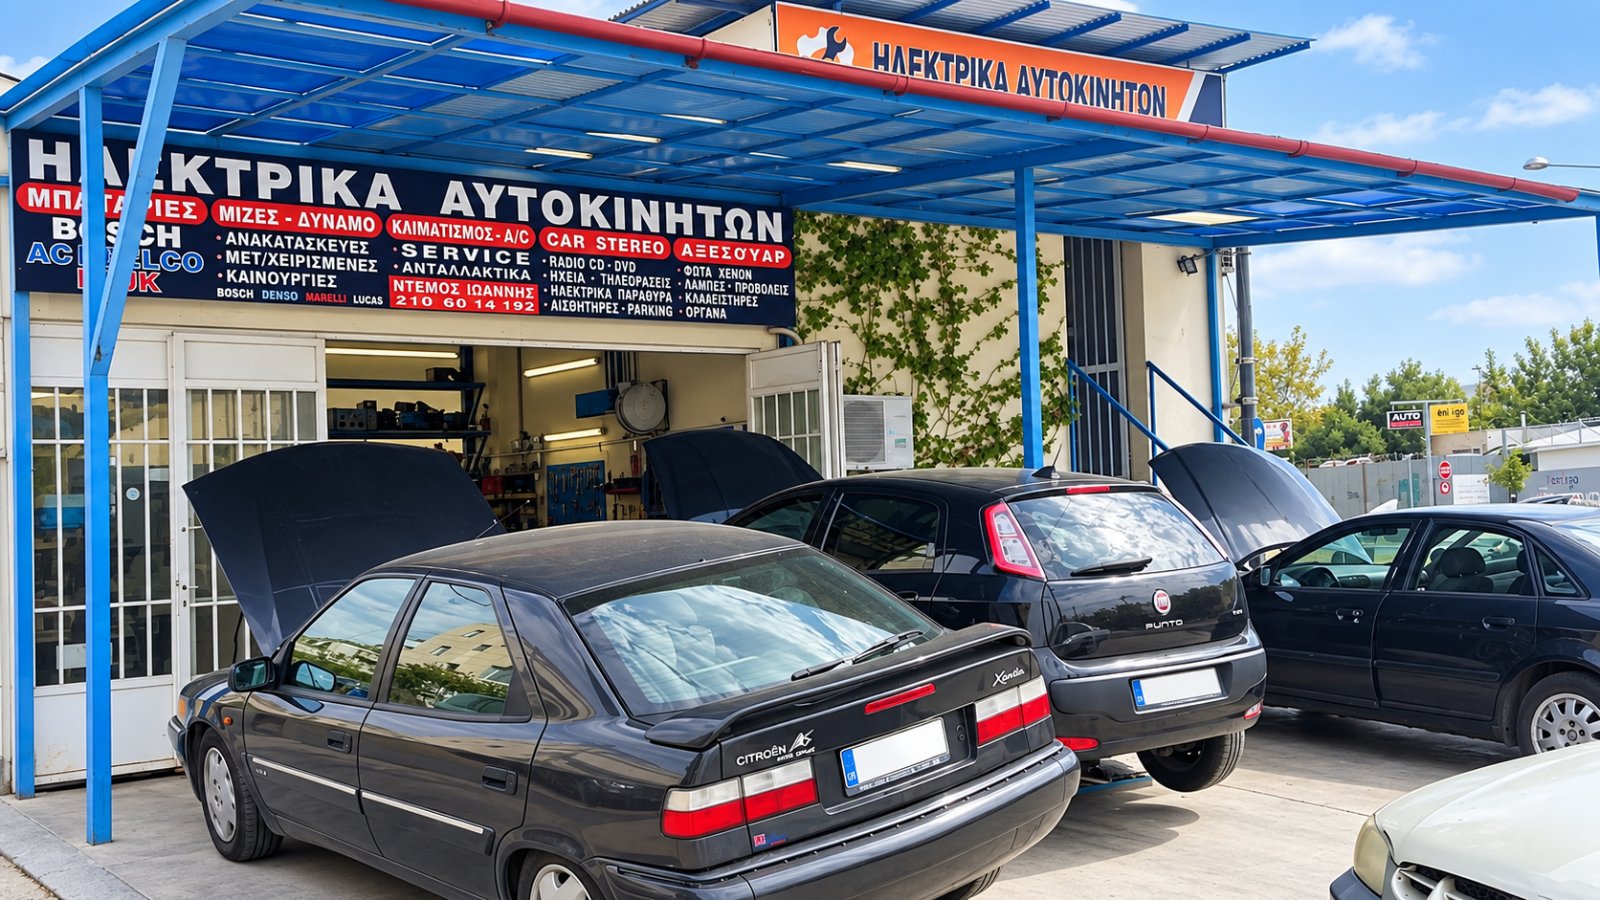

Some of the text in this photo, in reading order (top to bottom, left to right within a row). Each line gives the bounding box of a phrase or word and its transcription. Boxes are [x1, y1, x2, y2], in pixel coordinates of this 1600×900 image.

[28, 187, 198, 219] ΜΠΤΑΙΕΣ
[440, 180, 783, 243] ΑΥΤΟΚΙΝΗΤΩΝ
[219, 205, 279, 225] ΜΙΖΕΣ
[298, 211, 375, 232] ΔΥΝΑΜΟ
[52, 217, 181, 248] BSCH
[225, 232, 369, 255] ΑΝΑΚΑΤΑΣΚΕΥΕΣ
[547, 232, 664, 255] CAR STEREO
[26, 242, 74, 265] AC
[226, 250, 378, 273] ΜΕΤ/ΧΕΙΡΙΣΜΕΝΕΣ
[401, 243, 531, 265] SERVICE
[402, 262, 532, 281] ΑΝΤΑΛΛΑΚΤΙΚΑ
[549, 256, 637, 273] RADIO CD DVD
[683, 265, 712, 278] ΦΩΤΑ
[226, 269, 338, 288] ΚΑΙΝΟΥΡΓΙΕΣ
[550, 270, 672, 289] ΗΧΕΙΑ ΤΗΛΕΟΡΑΣΕΙΣ
[684, 278, 789, 296] ΛΑΜΠΕΣ ΠΡΟΒΟΛΕΙΣ
[216, 287, 384, 305] BOSCH DENSO MARELLI LUCAS
[393, 279, 535, 299] ΝΤΕΜΟΣ ΙΩΑΝΝΗΣ
[618, 288, 673, 303] ΠΑΡΑΘΥΡΑ
[395, 296, 535, 311] 210 60 14 192
[551, 299, 673, 317] ΑΙΣΘΗΤΗΡΕΣ PARKING
[685, 306, 727, 319] ΟΡΓΑΝΑ
[1392, 412, 1421, 421] AUTO
[1145, 619, 1184, 630] PUNTO
